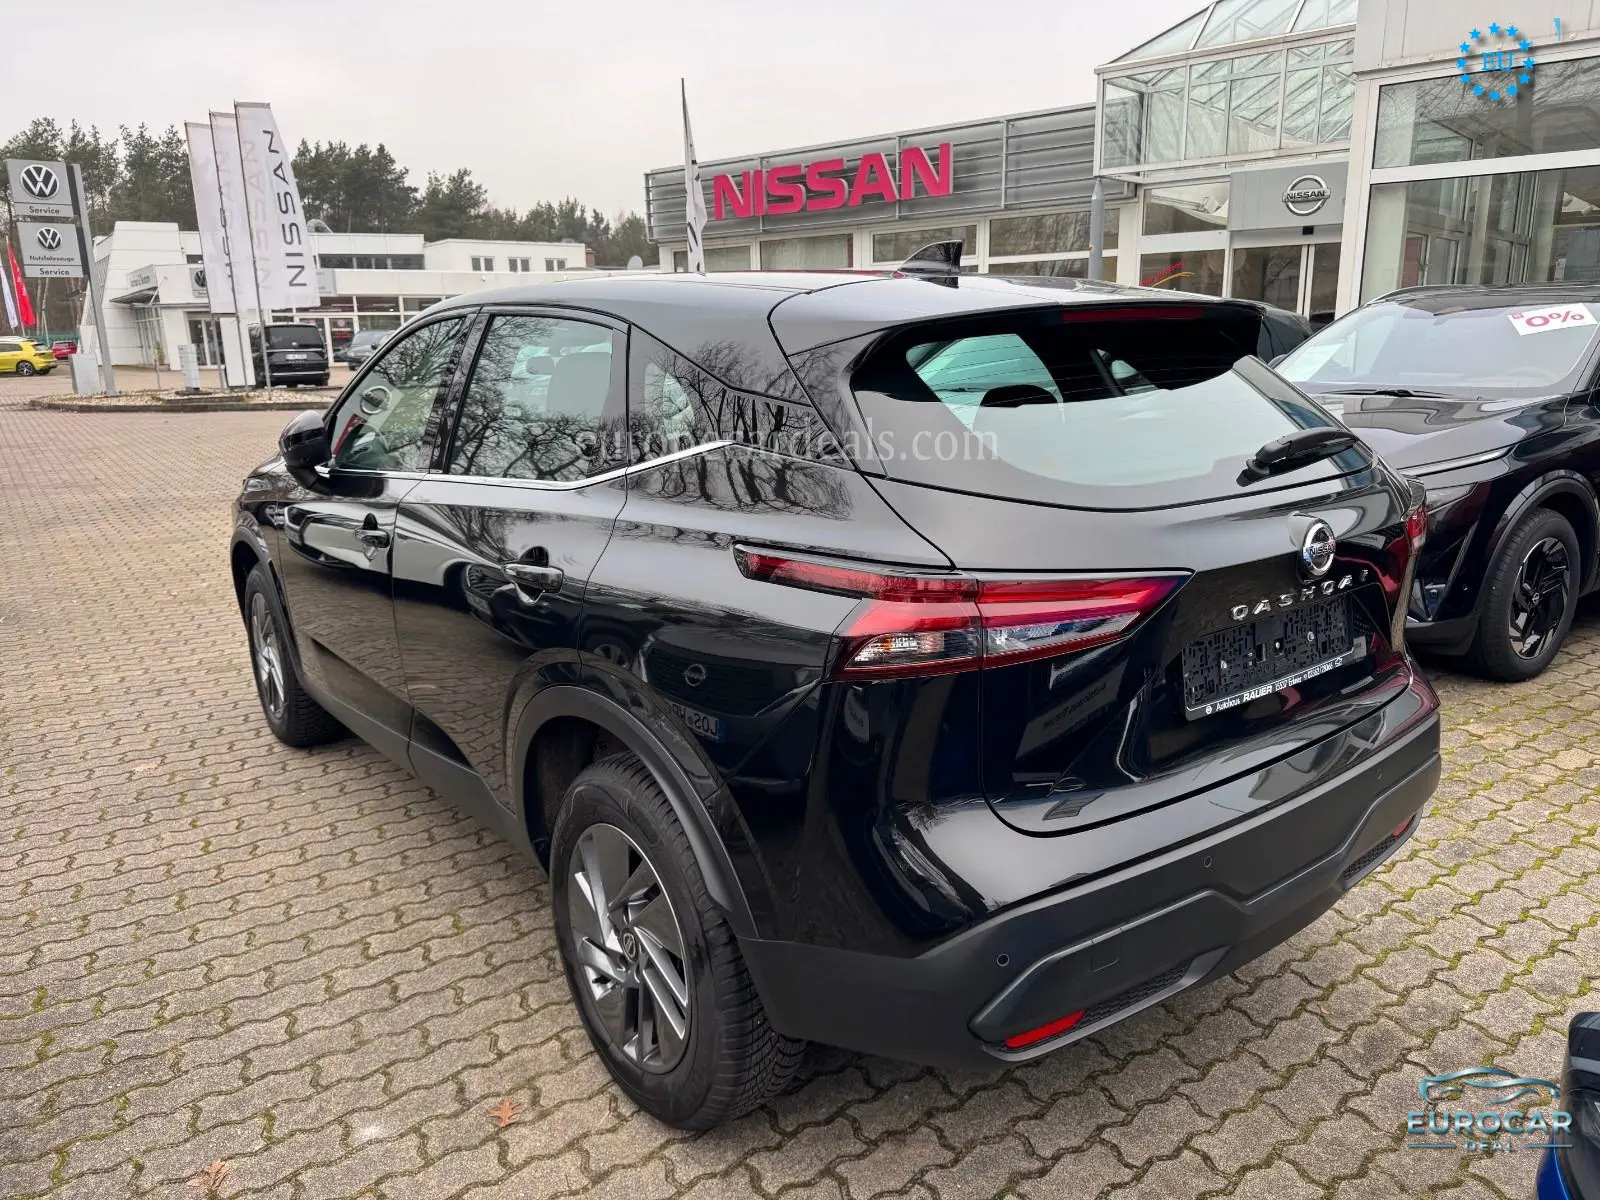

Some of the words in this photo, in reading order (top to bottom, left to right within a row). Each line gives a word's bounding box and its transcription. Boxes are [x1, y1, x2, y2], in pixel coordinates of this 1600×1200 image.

[712, 142, 953, 221] NISSAN
[1286, 190, 1325, 200] NISSAN
[29, 205, 60, 215] Service
[262, 129, 307, 288] NISSAN
[39, 268, 70, 276] Service
[1525, 310, 1585, 327] 0%
[1215, 697, 1241, 712] Autohaus
[1243, 685, 1273, 703] RAUER
